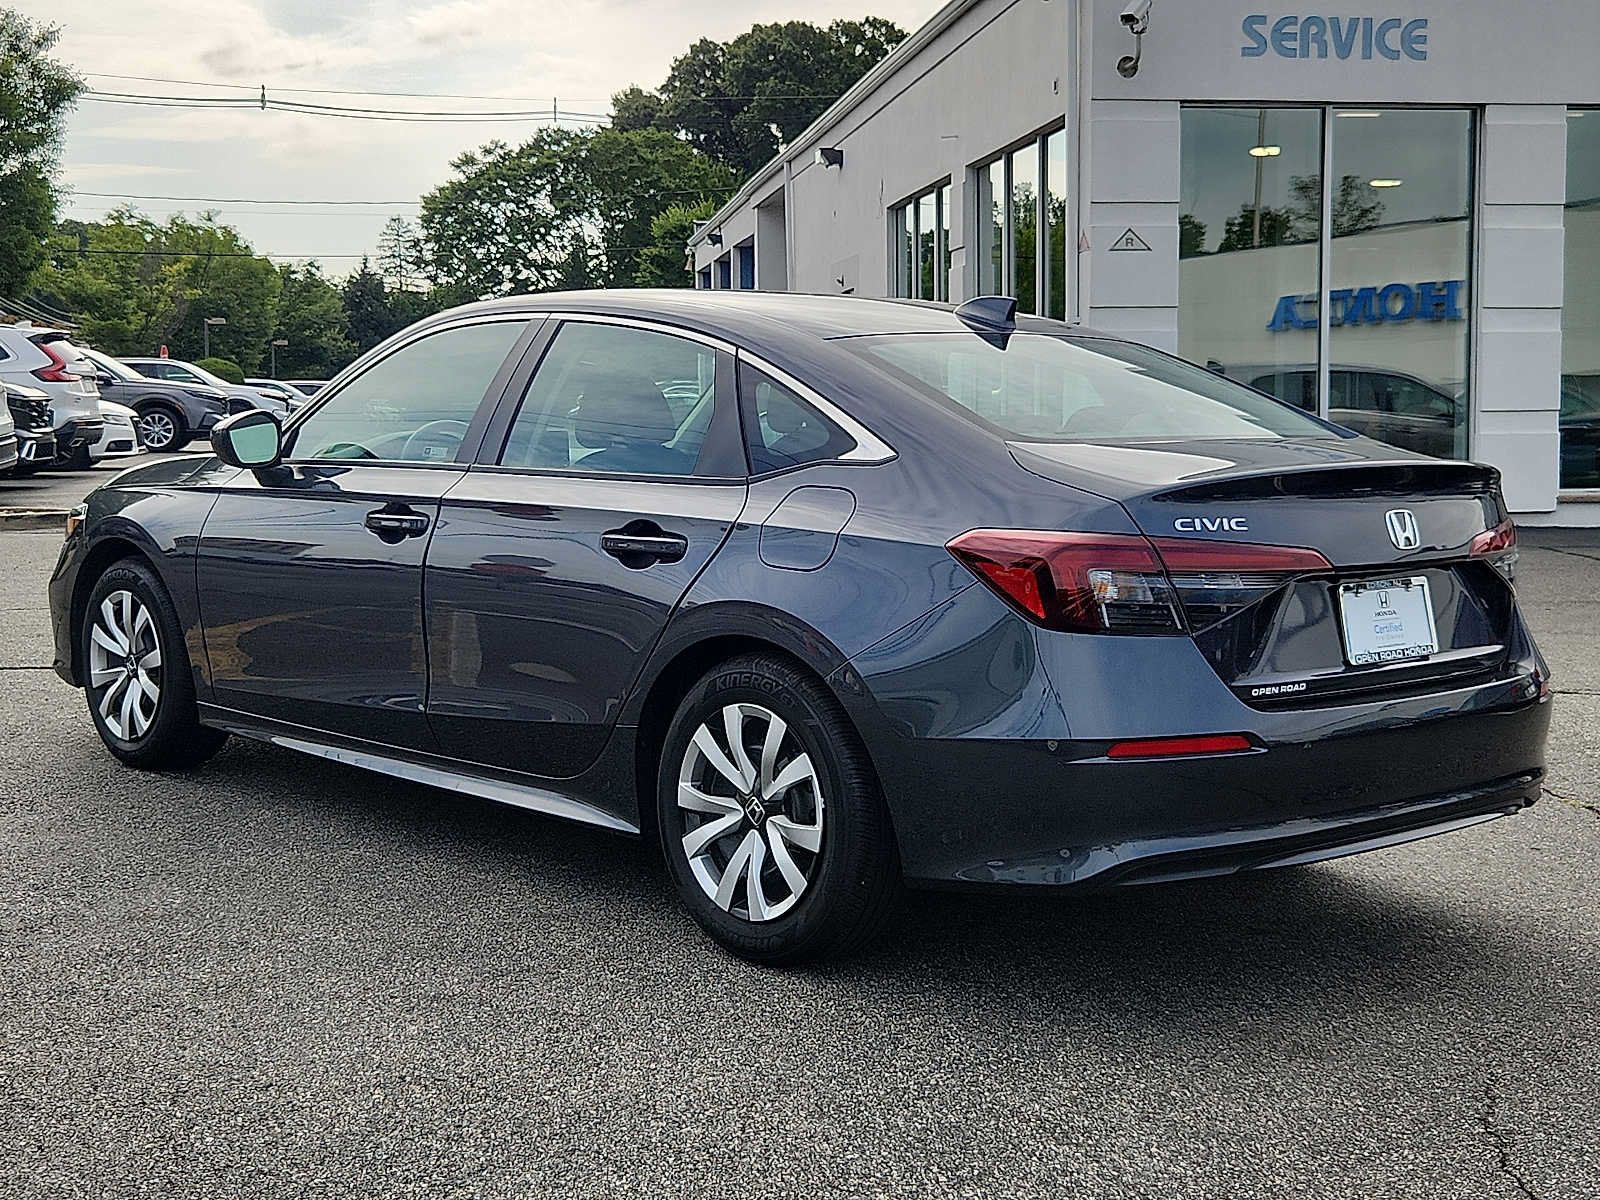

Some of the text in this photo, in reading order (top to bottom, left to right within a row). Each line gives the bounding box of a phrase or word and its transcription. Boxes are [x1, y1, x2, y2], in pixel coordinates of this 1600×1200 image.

[1240, 15, 1428, 61] SERVICE
[1125, 237, 1134, 248] R
[1173, 516, 1249, 532] CIVIC
[1374, 609, 1398, 617] HONDA
[1355, 645, 1434, 664] OPEN ROAD HONDA
[1251, 682, 1307, 696] OPEN ROAD
